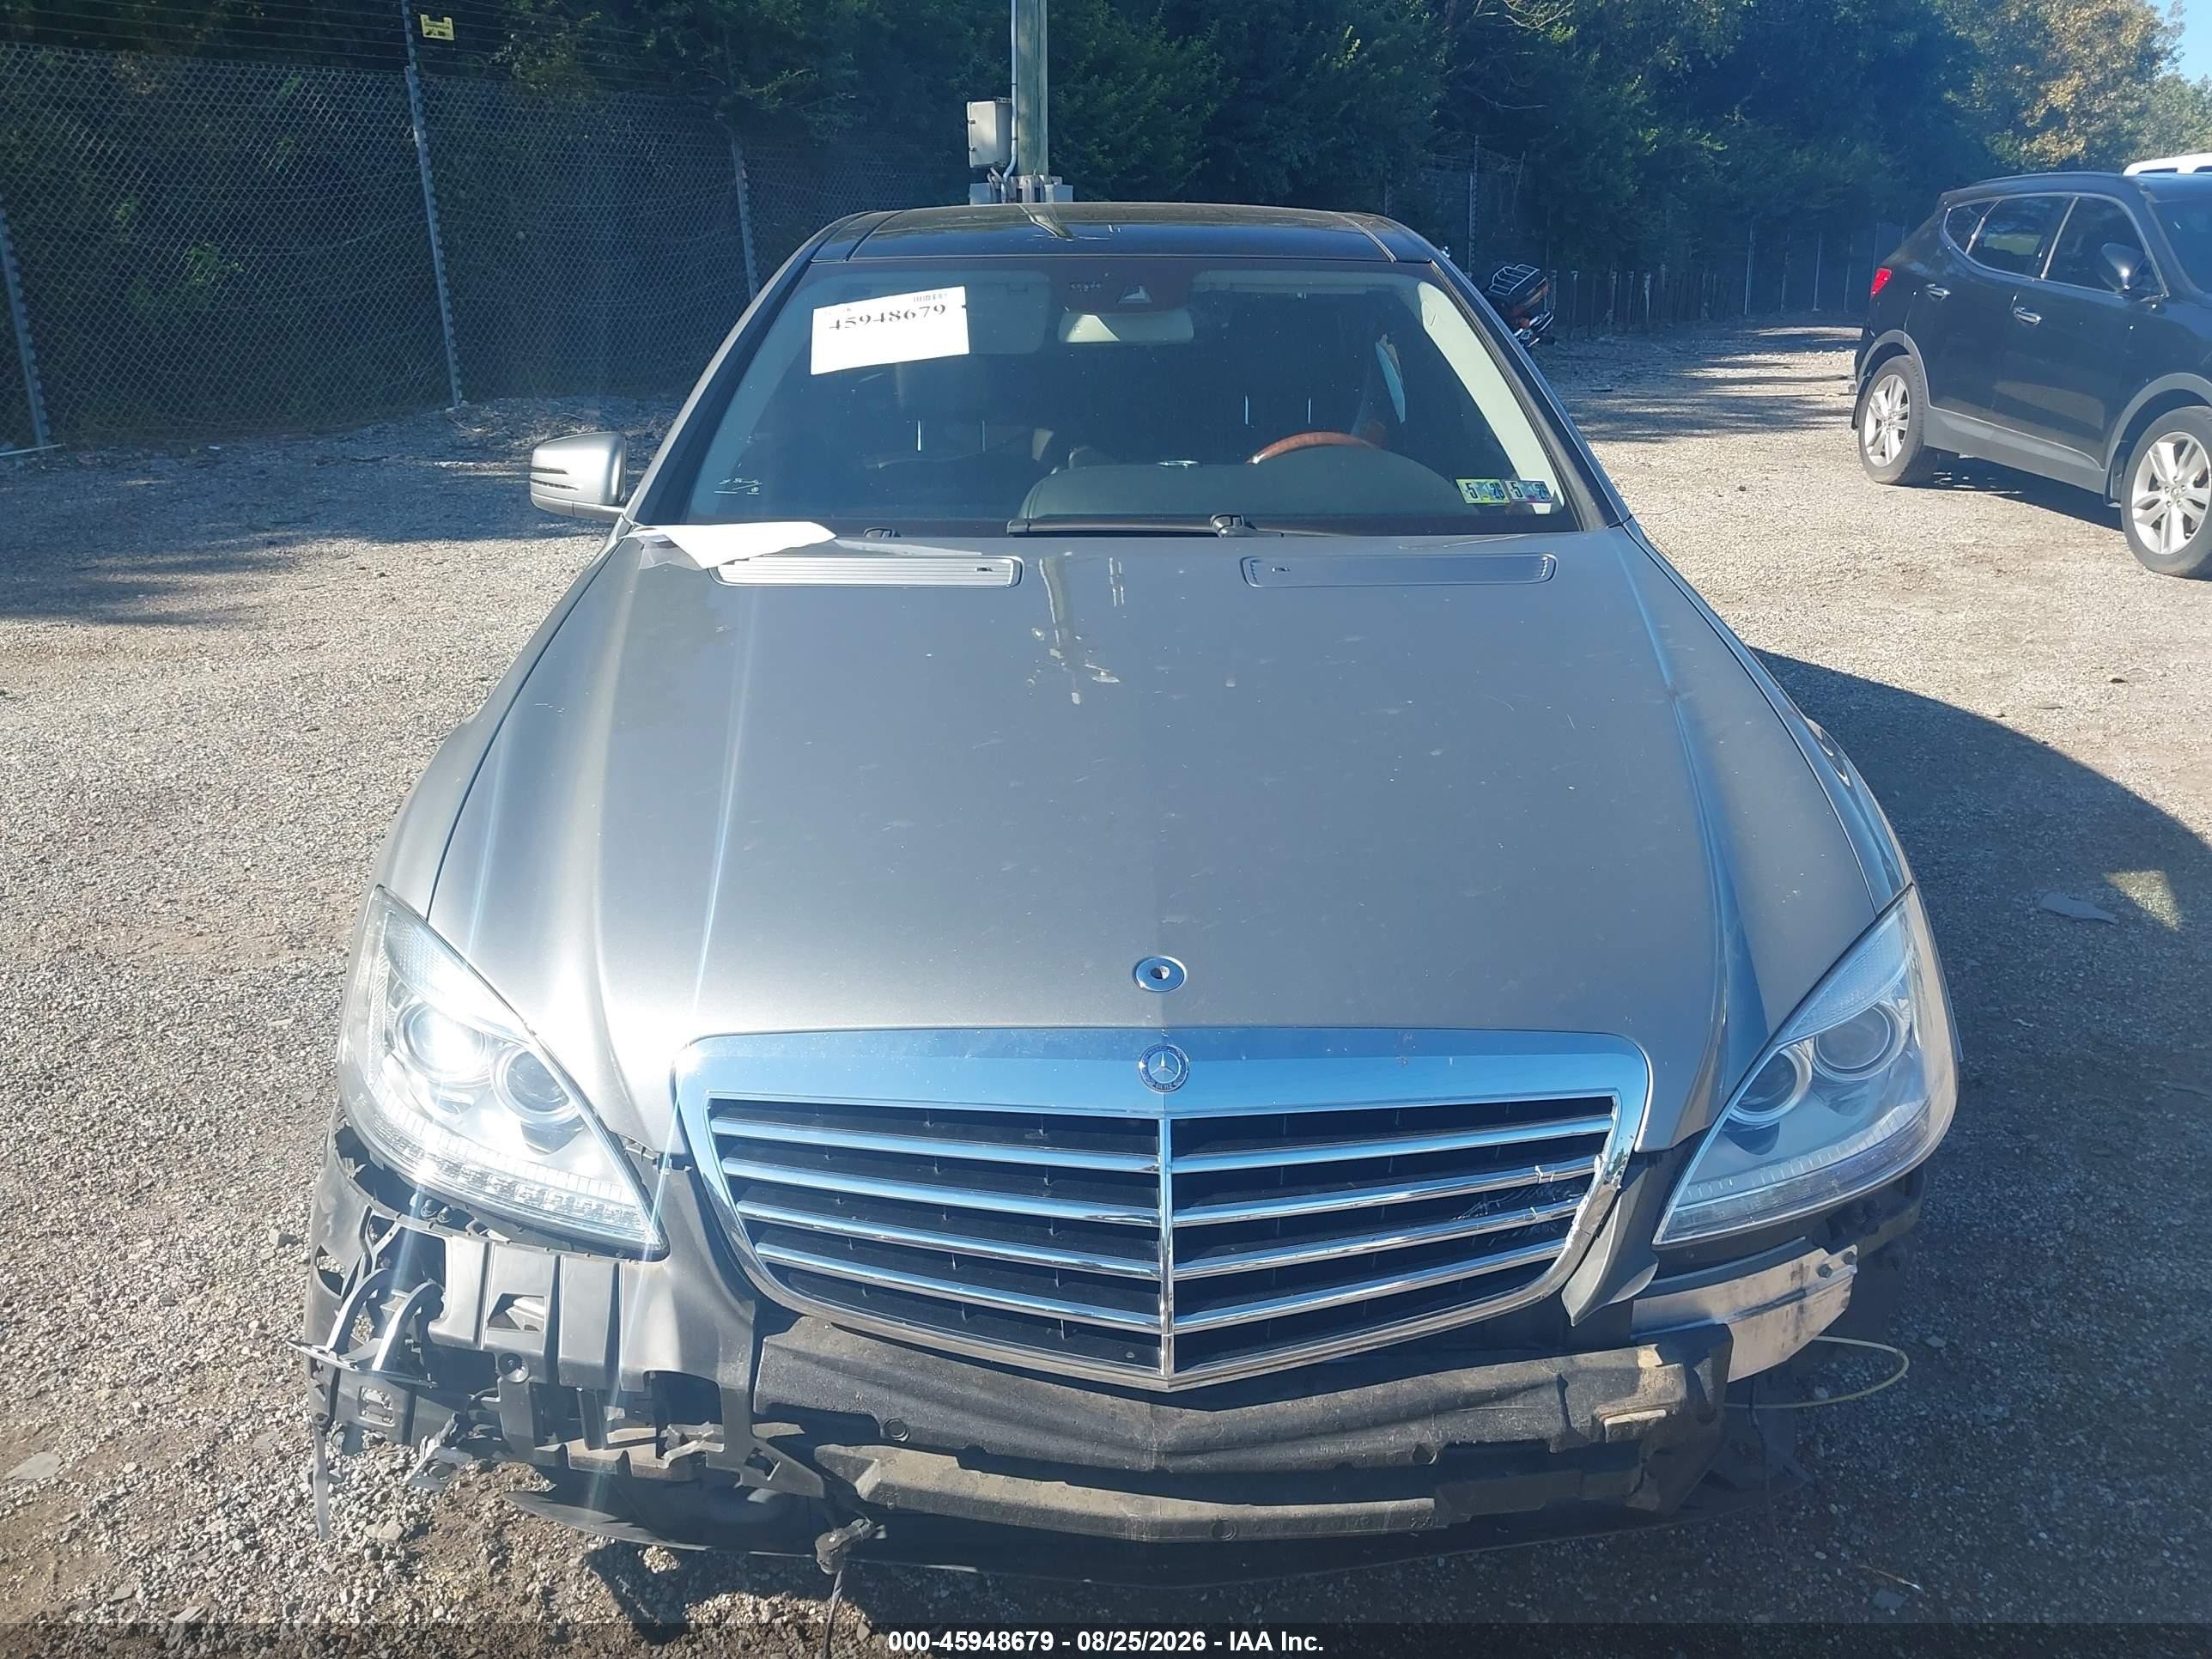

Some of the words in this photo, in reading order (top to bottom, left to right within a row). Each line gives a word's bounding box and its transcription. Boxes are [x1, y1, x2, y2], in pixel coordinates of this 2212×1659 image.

[829, 303, 946, 331] 45948679
[1465, 482, 1479, 499] 5
[1490, 483, 1506, 501] 26
[1510, 482, 1523, 498] 5
